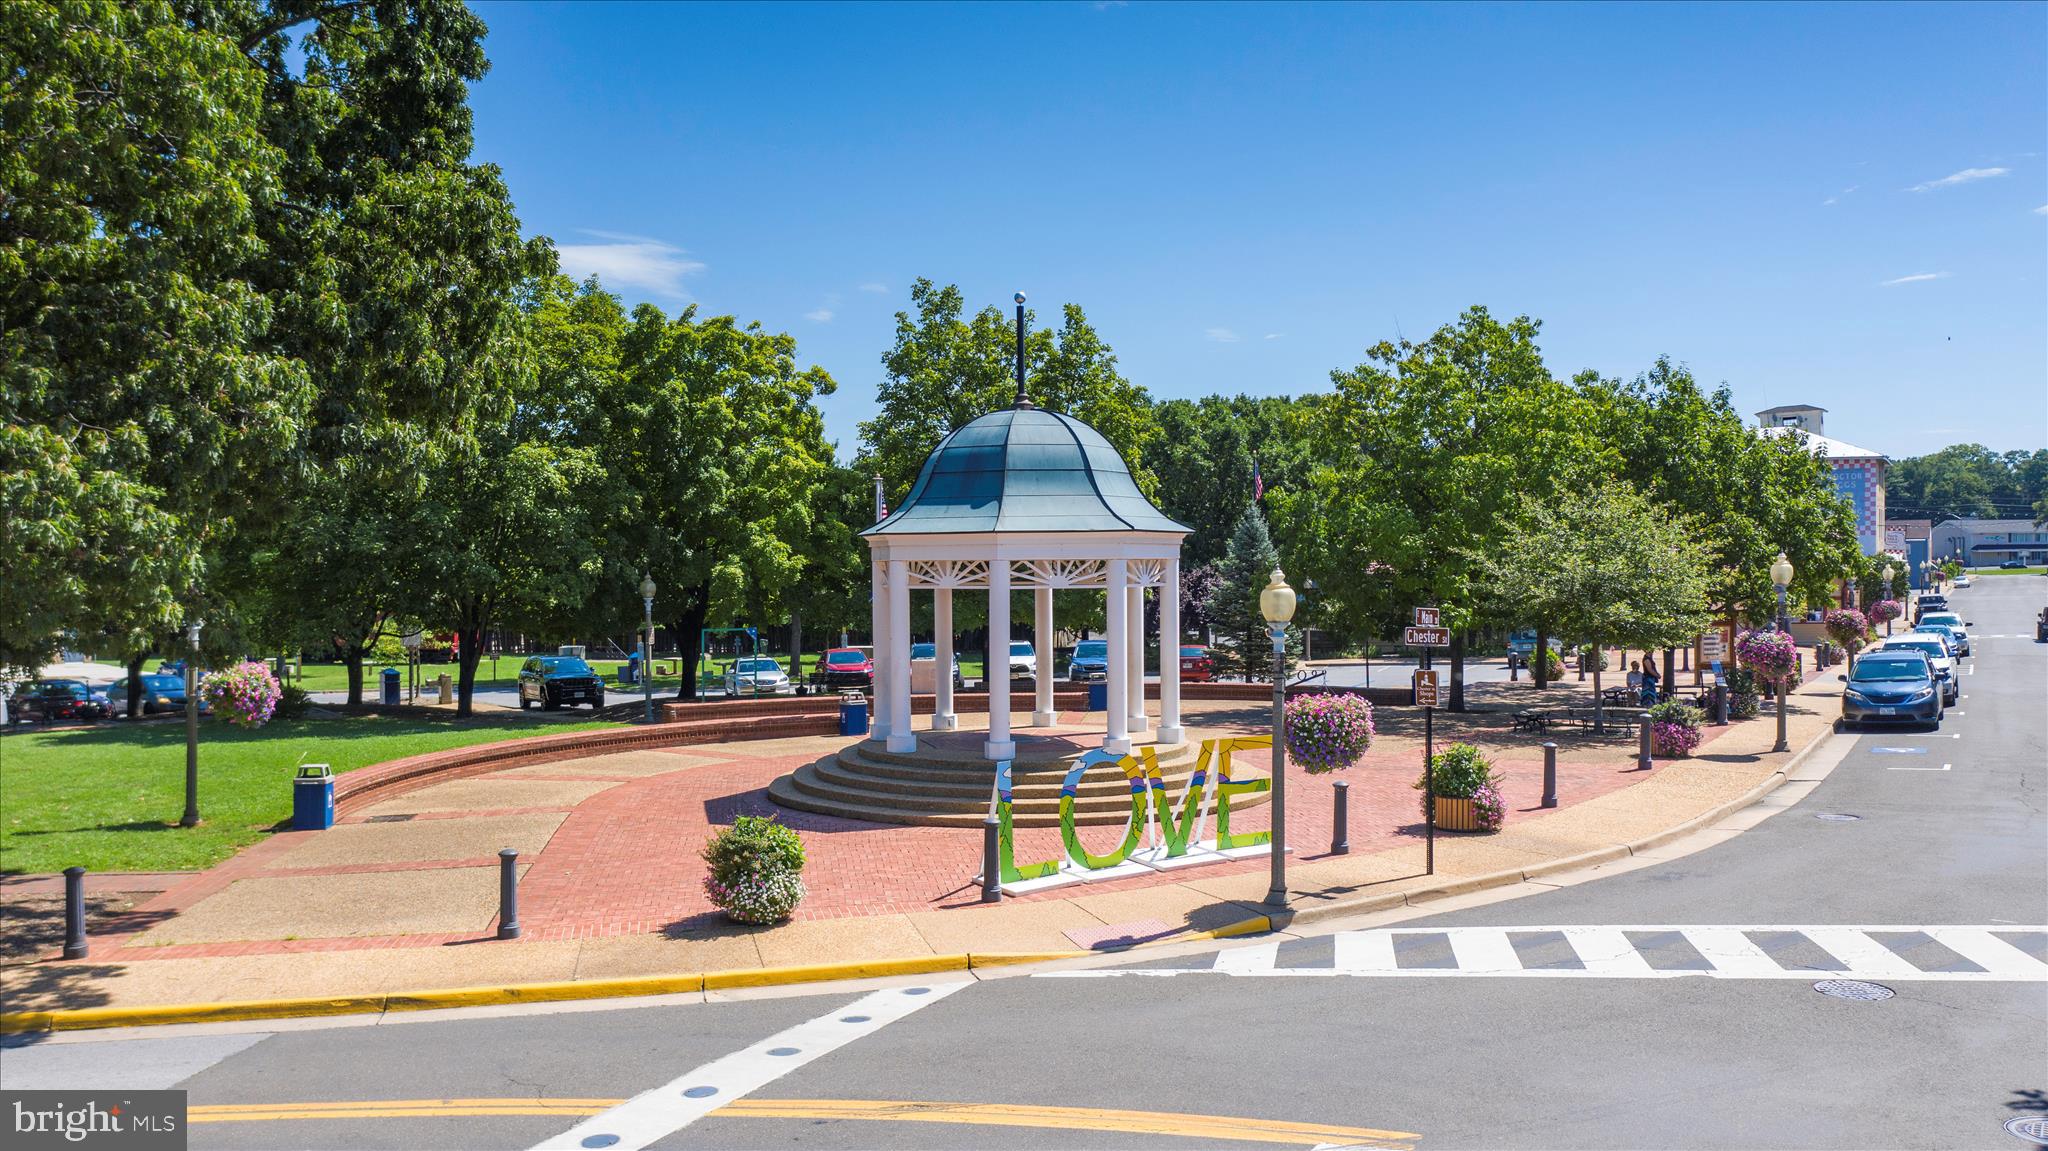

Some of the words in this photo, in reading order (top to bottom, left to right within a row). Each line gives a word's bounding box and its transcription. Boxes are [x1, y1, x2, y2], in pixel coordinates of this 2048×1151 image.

[1421, 610, 1433, 624] Main
[1407, 629, 1440, 643] Chester
[996, 735, 1273, 884] LOVE
